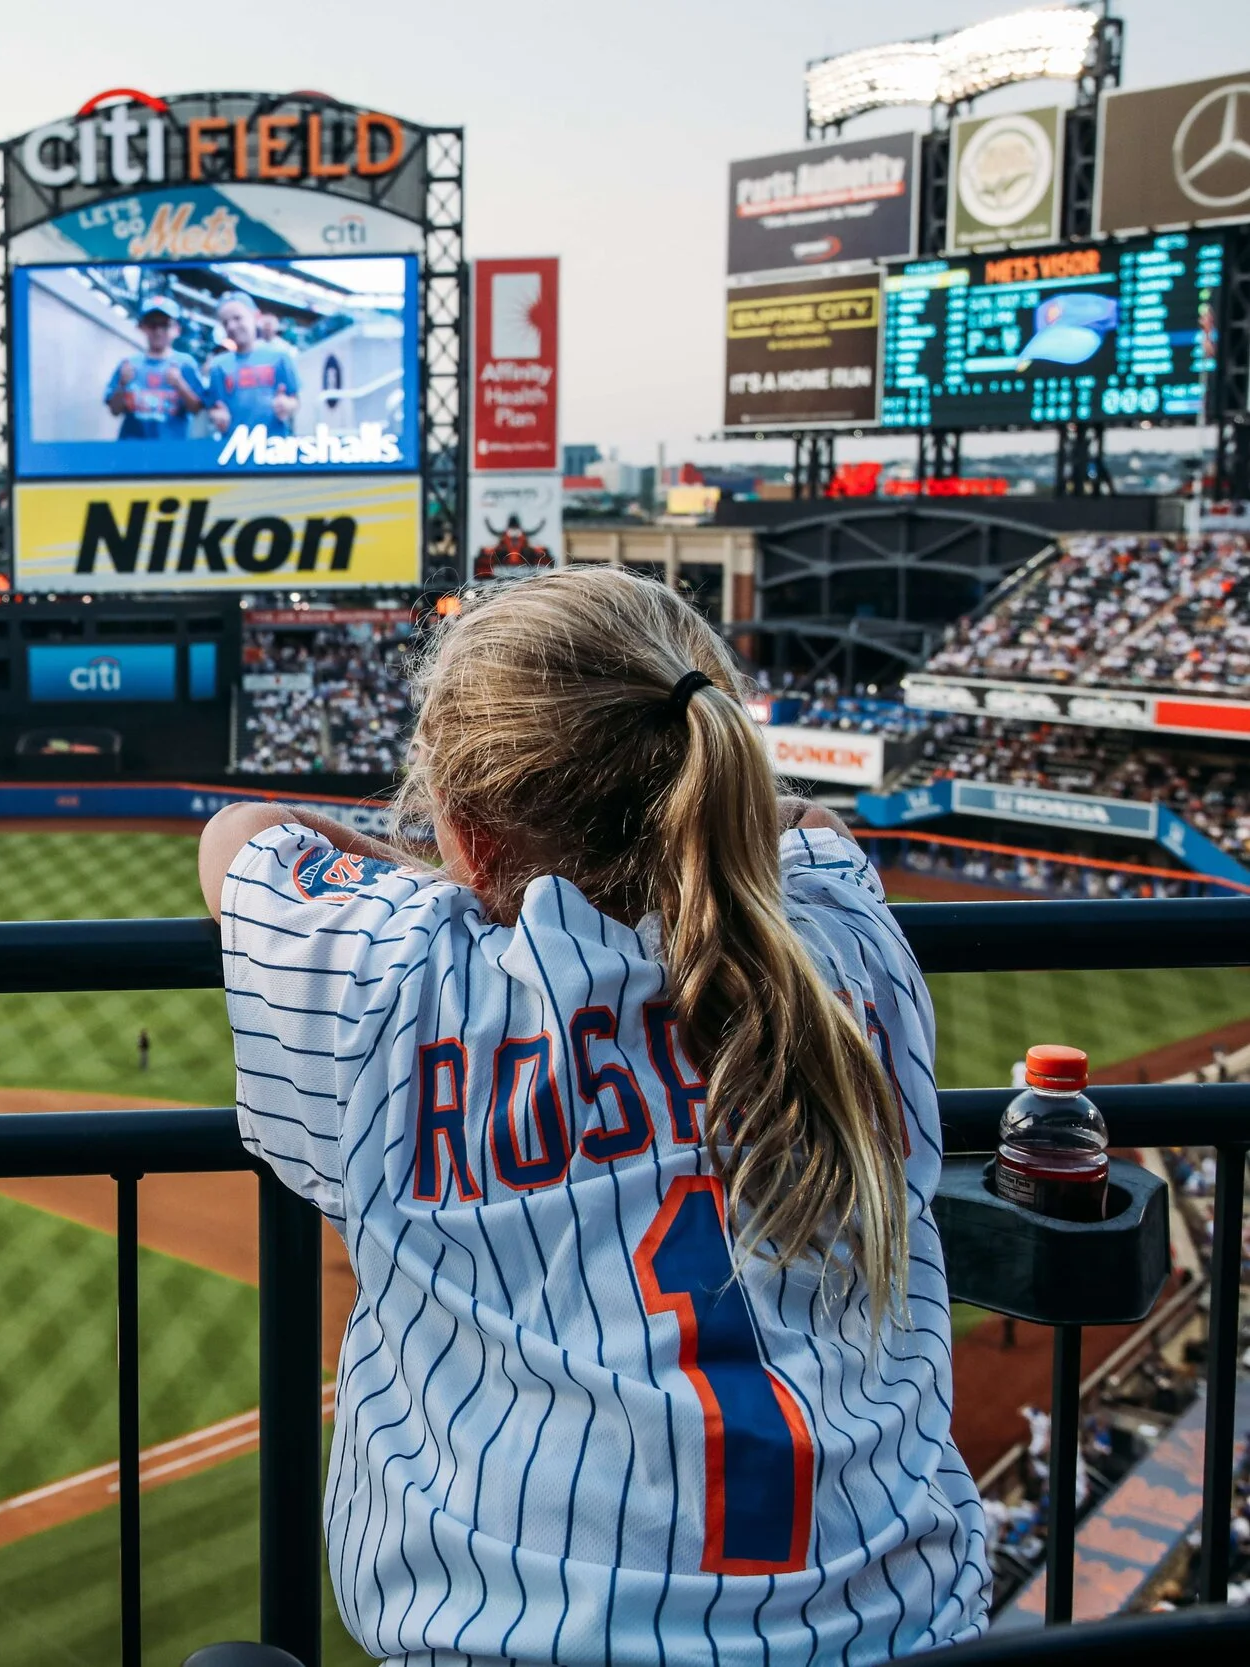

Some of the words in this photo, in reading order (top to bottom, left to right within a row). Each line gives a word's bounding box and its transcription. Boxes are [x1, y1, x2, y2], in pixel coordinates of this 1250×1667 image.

[24, 103, 165, 185] citi
[187, 113, 404, 180] FIELD
[737, 171, 795, 205] Parts
[796, 152, 906, 196] Authority
[78, 199, 144, 230] LET'S
[113, 218, 146, 240] GO
[129, 201, 239, 258] Mets
[323, 218, 366, 246] citi
[985, 256, 1038, 284] METS
[1039, 249, 1101, 278] VISOR
[734, 304, 815, 328] EMPIRE
[817, 300, 870, 321] CITY
[480, 363, 553, 386] Affinity
[762, 371, 777, 393] A
[777, 368, 830, 392] HOME
[831, 366, 872, 389] RUN
[484, 385, 549, 406] Health
[495, 407, 537, 428] Plan
[217, 422, 400, 467] Marshalls
[75, 496, 358, 575] Nikon
[69, 664, 121, 691] citi
[1015, 795, 1111, 825] HONDA
[412, 990, 911, 1203] ROSA
[633, 1175, 814, 1576] 1
